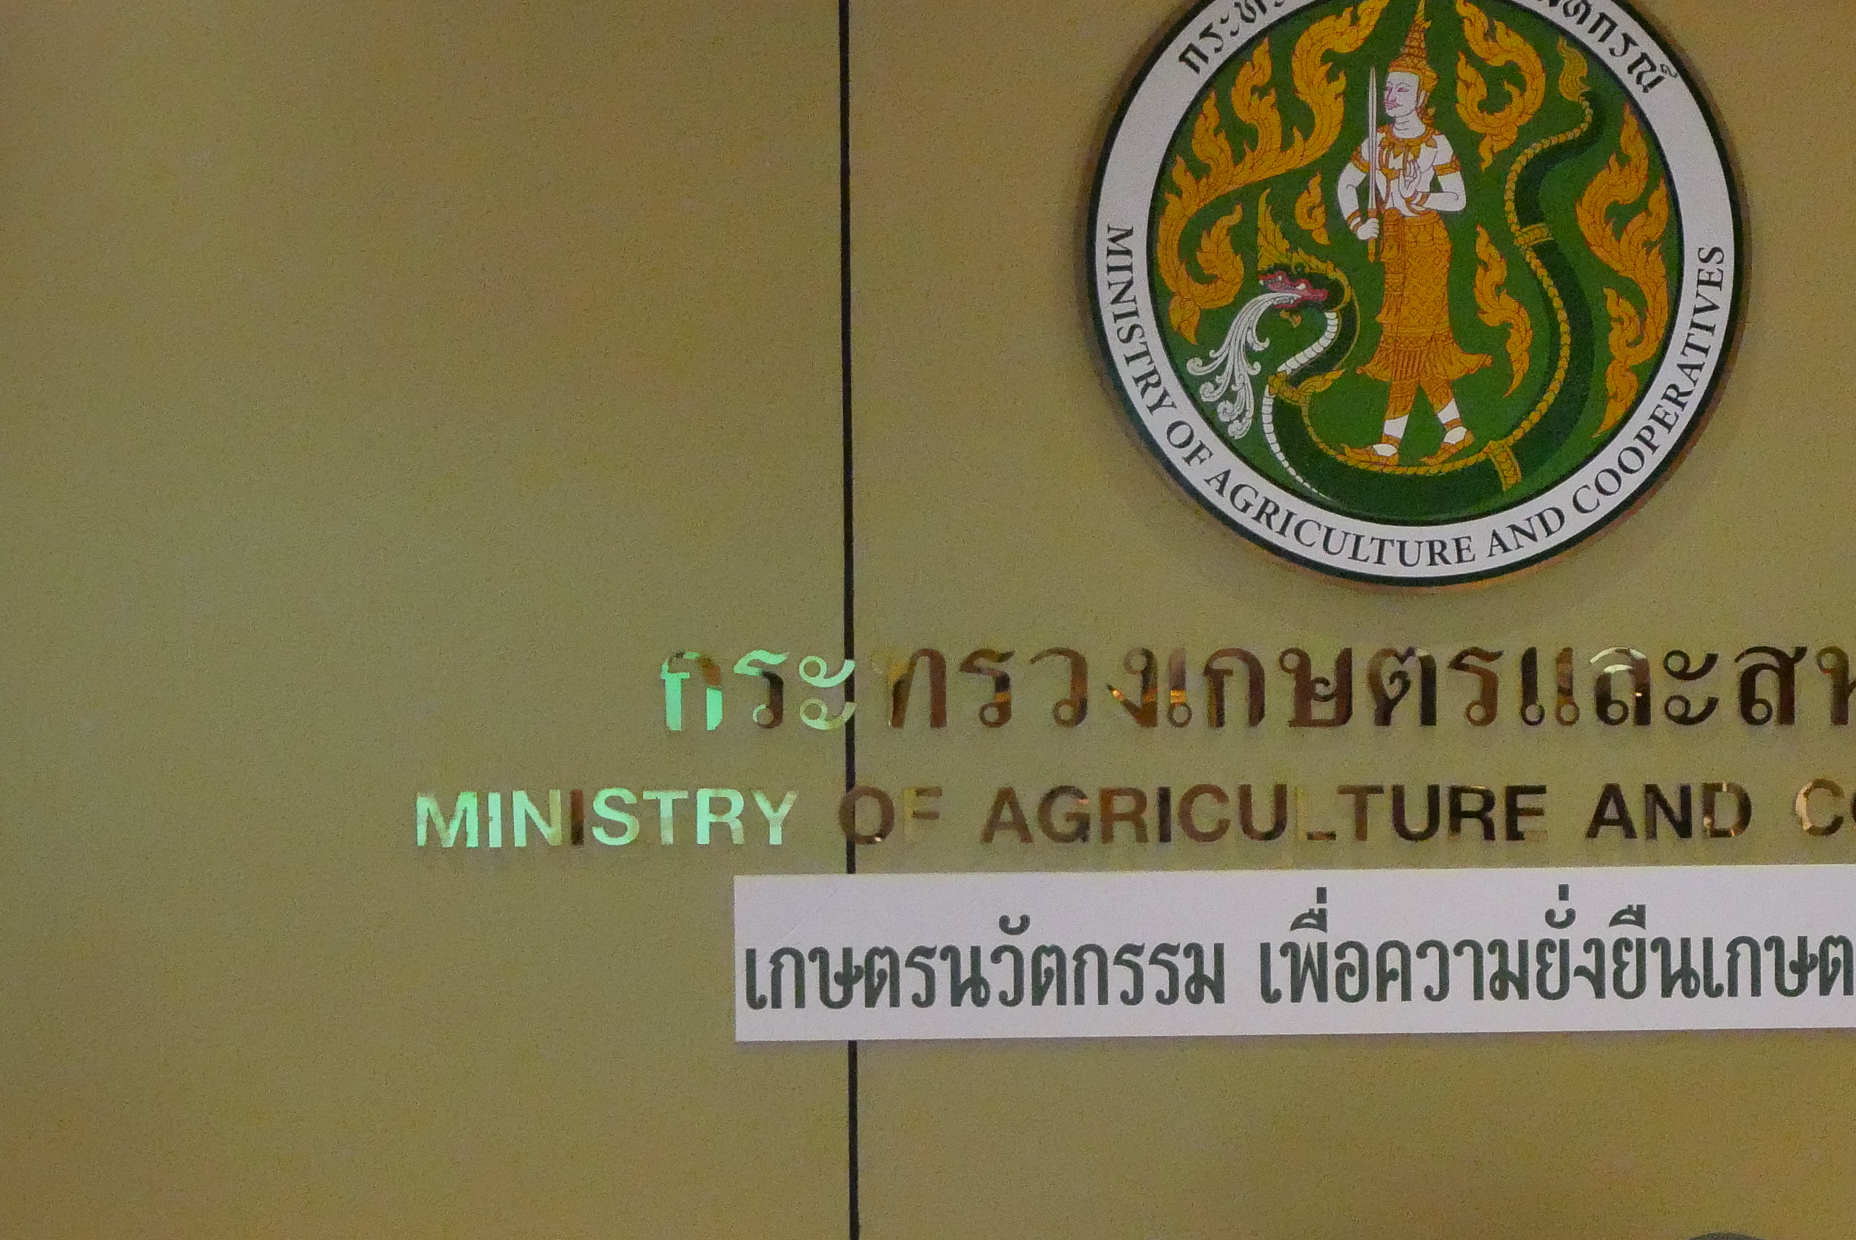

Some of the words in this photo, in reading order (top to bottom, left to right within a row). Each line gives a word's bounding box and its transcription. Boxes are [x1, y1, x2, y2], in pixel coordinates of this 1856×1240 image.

[1106, 223, 1178, 416] MINISTRY
[1166, 420, 1214, 467] OF
[1204, 468, 1476, 568] AGRICULTURE
[1487, 506, 1565, 558] AND
[1572, 246, 1725, 514] COOPERATIVES
[415, 787, 798, 849] MINISTRY
[839, 785, 943, 845] OF
[980, 782, 1549, 845] AGRICULTURE
[1585, 782, 1753, 842] AND
[745, 913, 1225, 1011] เกษตรนวัตกรรม
